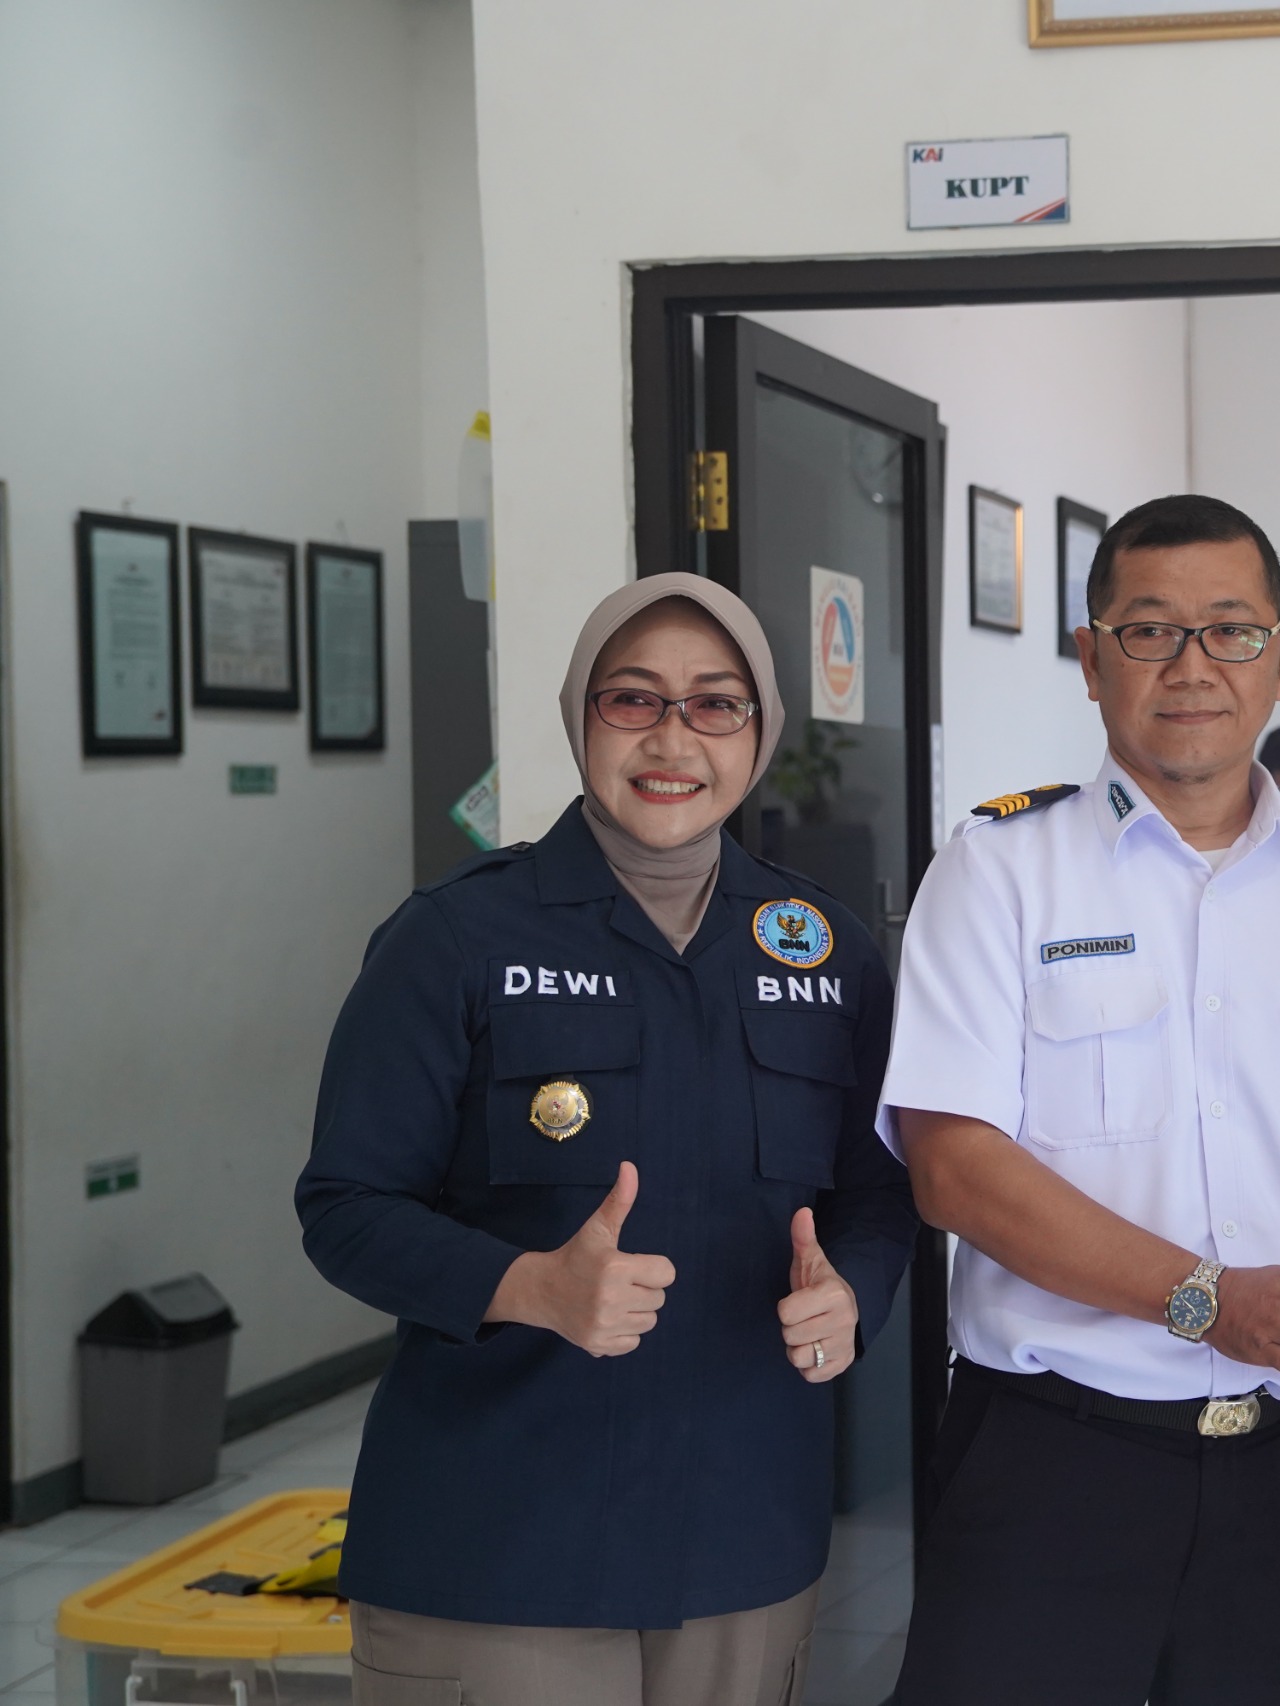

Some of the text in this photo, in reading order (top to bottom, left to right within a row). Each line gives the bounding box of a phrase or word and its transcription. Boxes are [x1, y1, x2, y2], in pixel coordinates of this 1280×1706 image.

[912, 147, 944, 163] KAI
[945, 176, 1029, 199] KUPT
[758, 909, 770, 926] BADAN
[806, 908, 828, 934] NASIONAL
[778, 938, 810, 952] BNN
[796, 942, 829, 964] INDONESIA
[1047, 939, 1128, 959] PONIMIN
[504, 965, 617, 997] DEWI
[757, 975, 843, 1006] BNN
